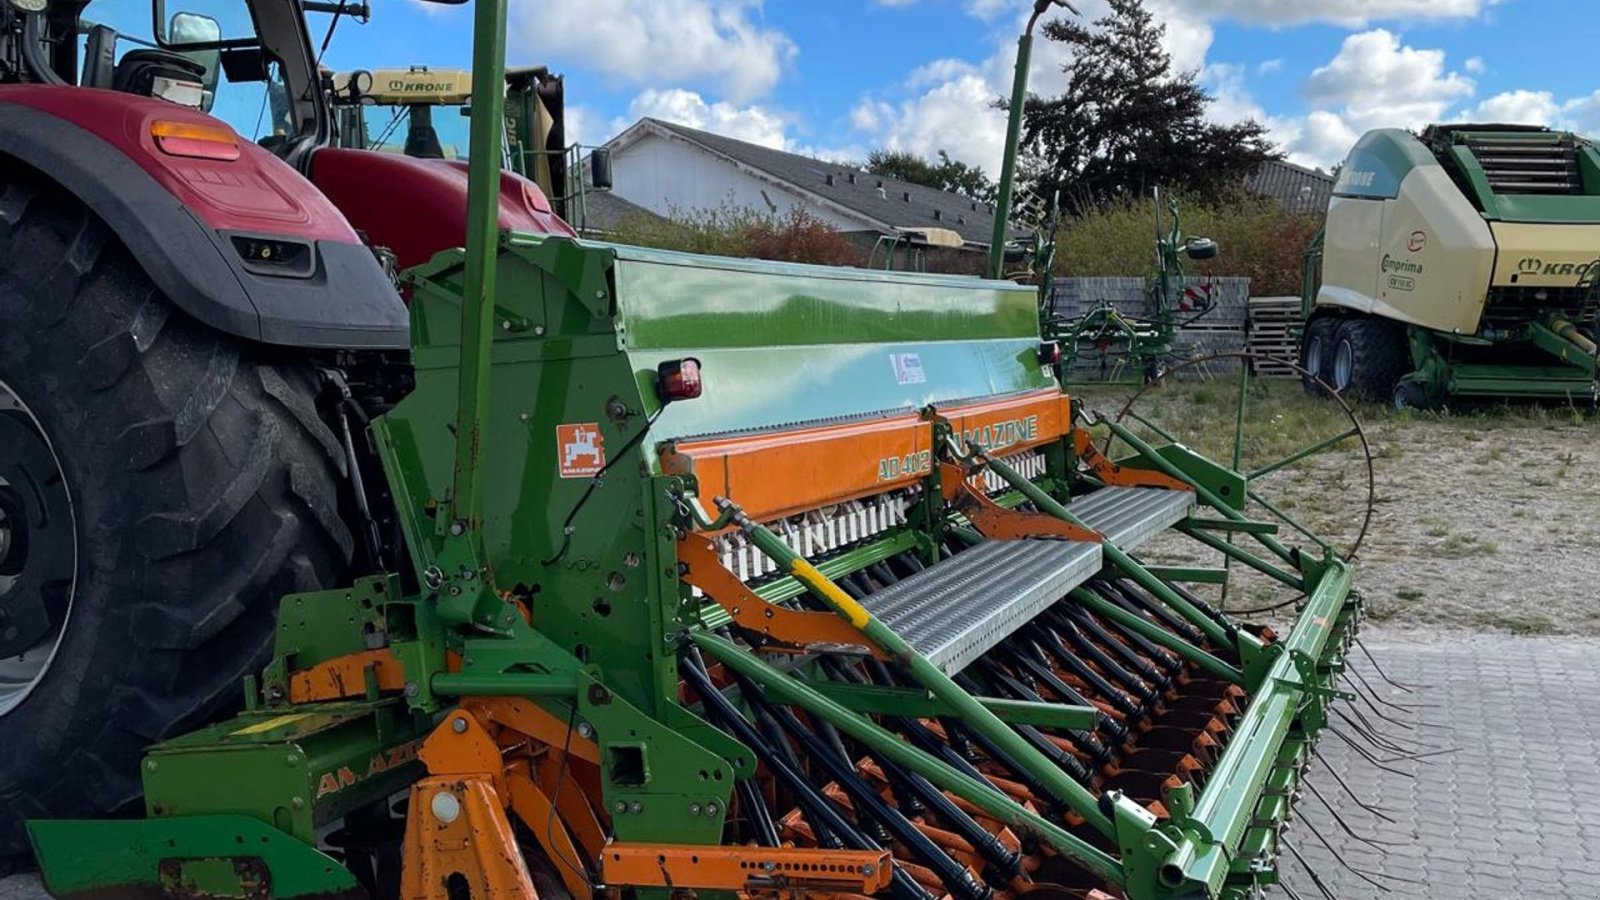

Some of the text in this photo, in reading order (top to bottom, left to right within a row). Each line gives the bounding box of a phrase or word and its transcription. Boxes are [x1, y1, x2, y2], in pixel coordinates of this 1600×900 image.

[404, 82, 453, 92] KRONE
[505, 116, 517, 146] BIG
[1381, 253, 1423, 275] Comprima
